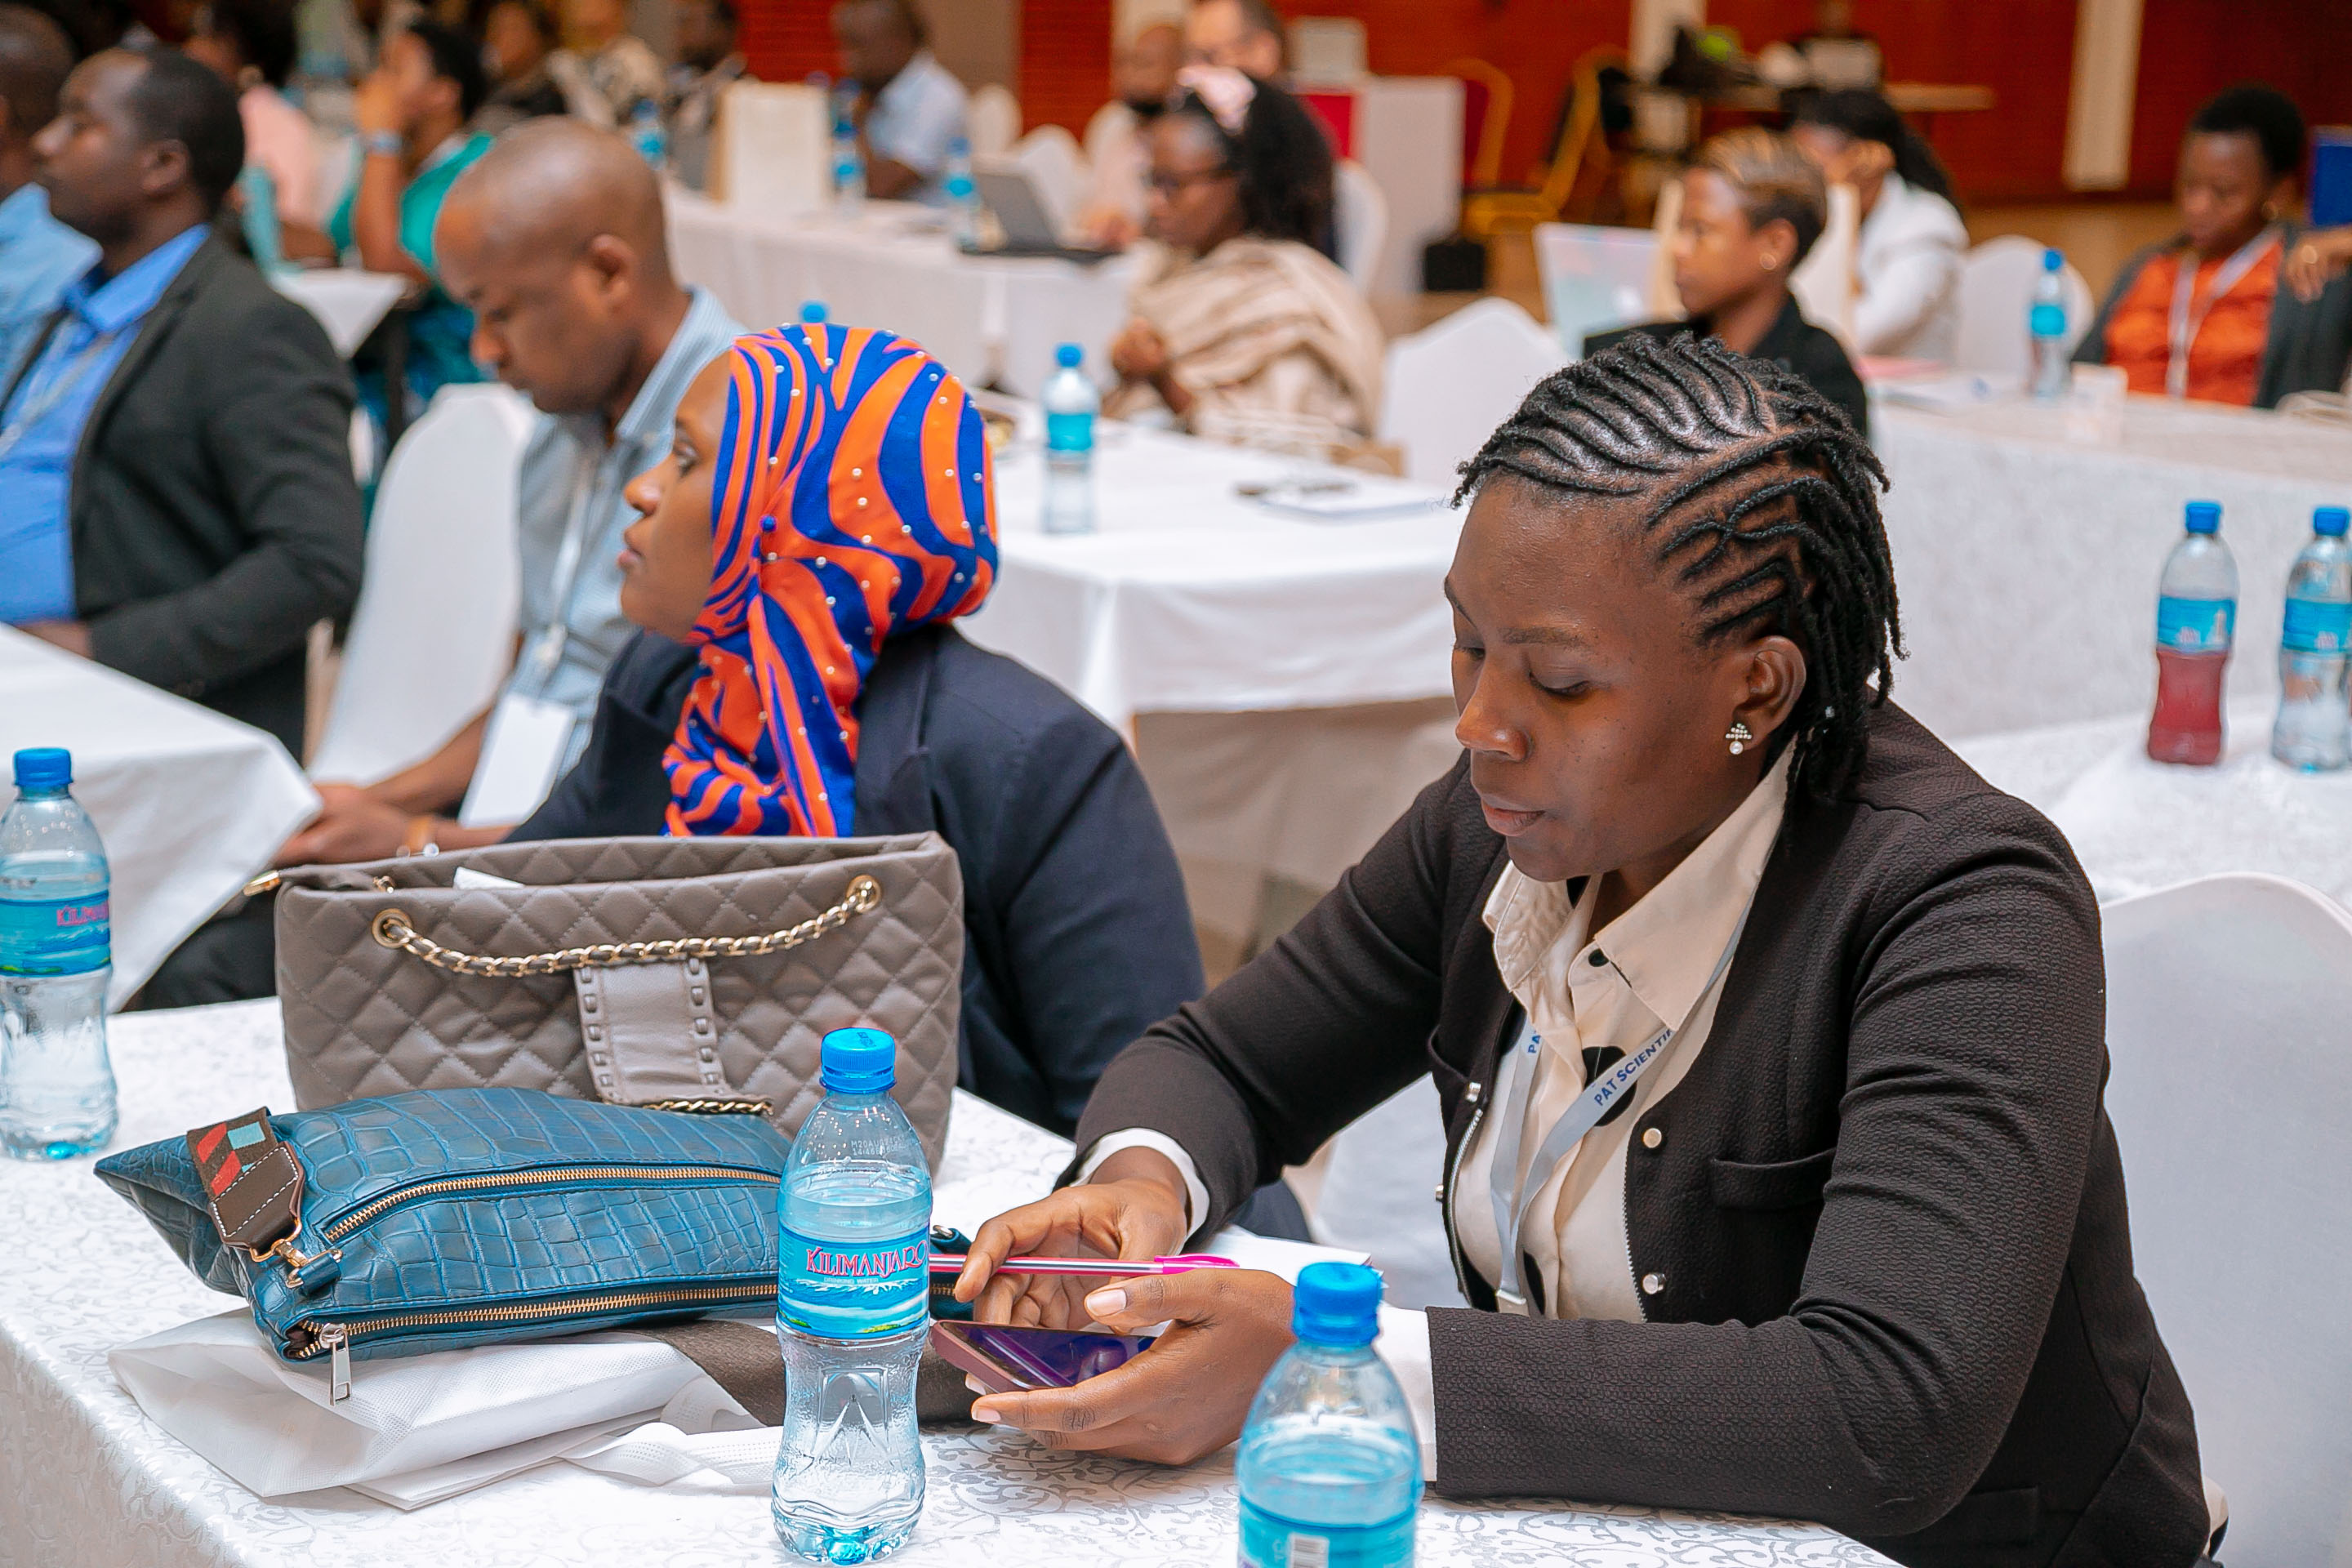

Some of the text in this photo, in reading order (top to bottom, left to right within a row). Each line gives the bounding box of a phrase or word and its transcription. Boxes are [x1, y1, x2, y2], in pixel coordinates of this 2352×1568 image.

[1528, 1030, 1542, 1054] PA
[1594, 1078, 1618, 1106] PAT
[806, 1240, 928, 1278] KILIMANJARO
[823, 1276, 855, 1285] DRINKING
